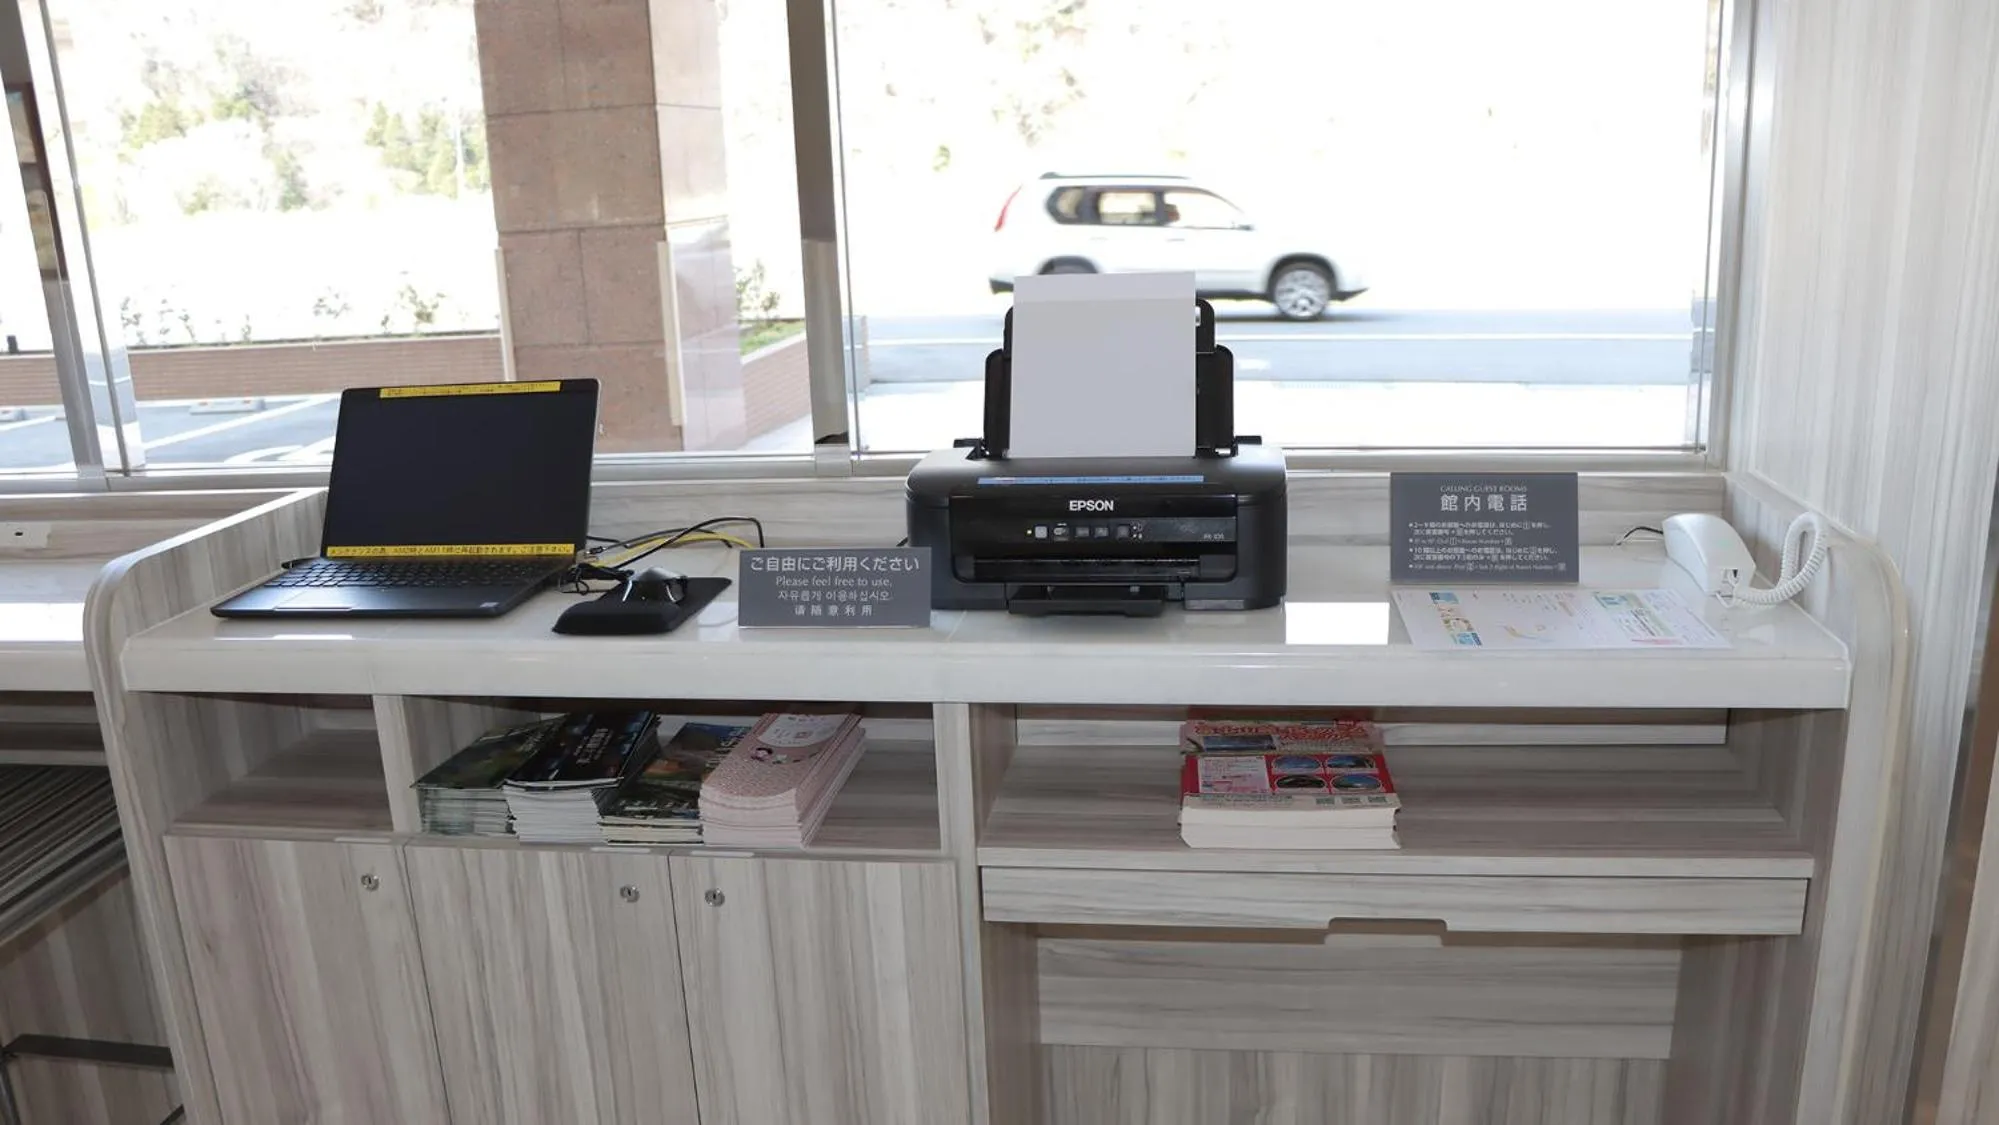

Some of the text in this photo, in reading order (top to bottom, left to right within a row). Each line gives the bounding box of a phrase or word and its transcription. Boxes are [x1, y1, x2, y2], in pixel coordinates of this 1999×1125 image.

[1069, 499, 1114, 511] EPSON
[1440, 493, 1528, 512] 館内電話
[750, 556, 920, 572] ご自由にご利用ください
[776, 575, 809, 587] Please
[812, 575, 831, 586] feel
[834, 575, 855, 587] free
[857, 577, 869, 586] to
